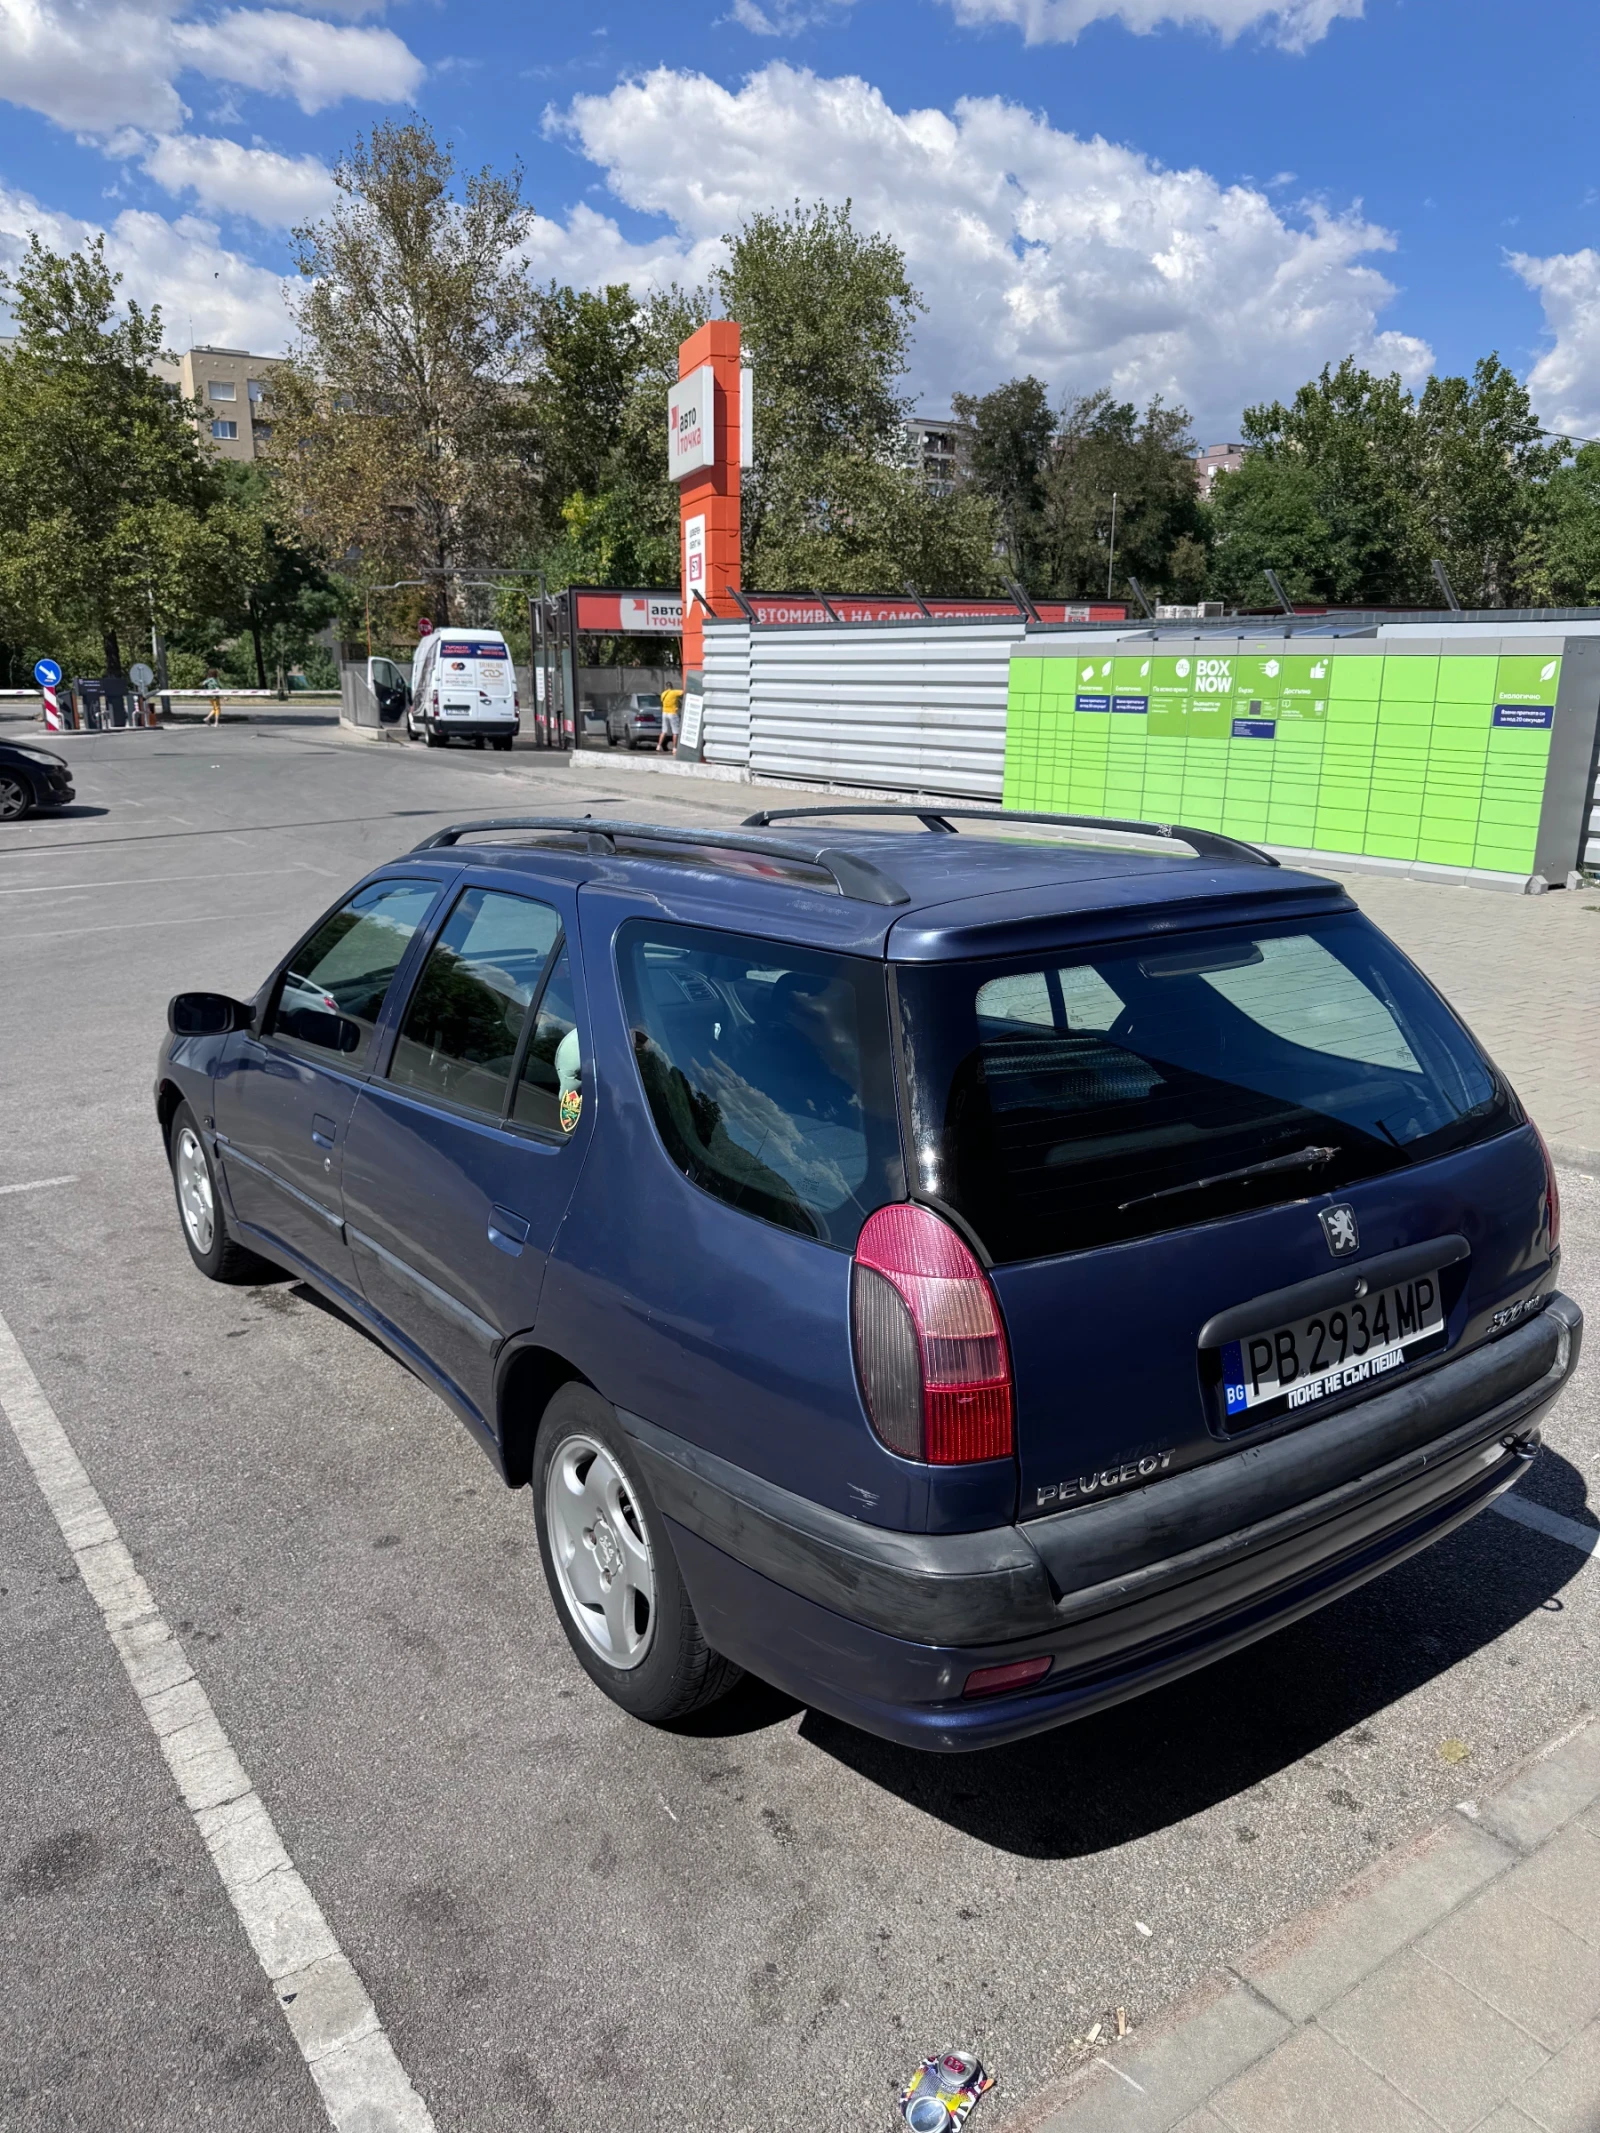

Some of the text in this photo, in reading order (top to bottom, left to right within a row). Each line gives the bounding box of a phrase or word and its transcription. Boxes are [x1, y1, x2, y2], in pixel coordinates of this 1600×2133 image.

[680, 407, 696, 432] авто
[680, 427, 702, 455] точка
[651, 606, 682, 616] авто
[1196, 659, 1231, 677] BOX
[1194, 676, 1233, 693] NOW
[1499, 692, 1541, 700] Екологично
[1248, 1278, 1435, 1397] PB 2934 MP
[1287, 1349, 1405, 1409] ПОНЕ НЕ СЪМ ПЕША
[1226, 1384, 1245, 1405] BG
[1036, 1448, 1176, 1506] PEUGEOT
